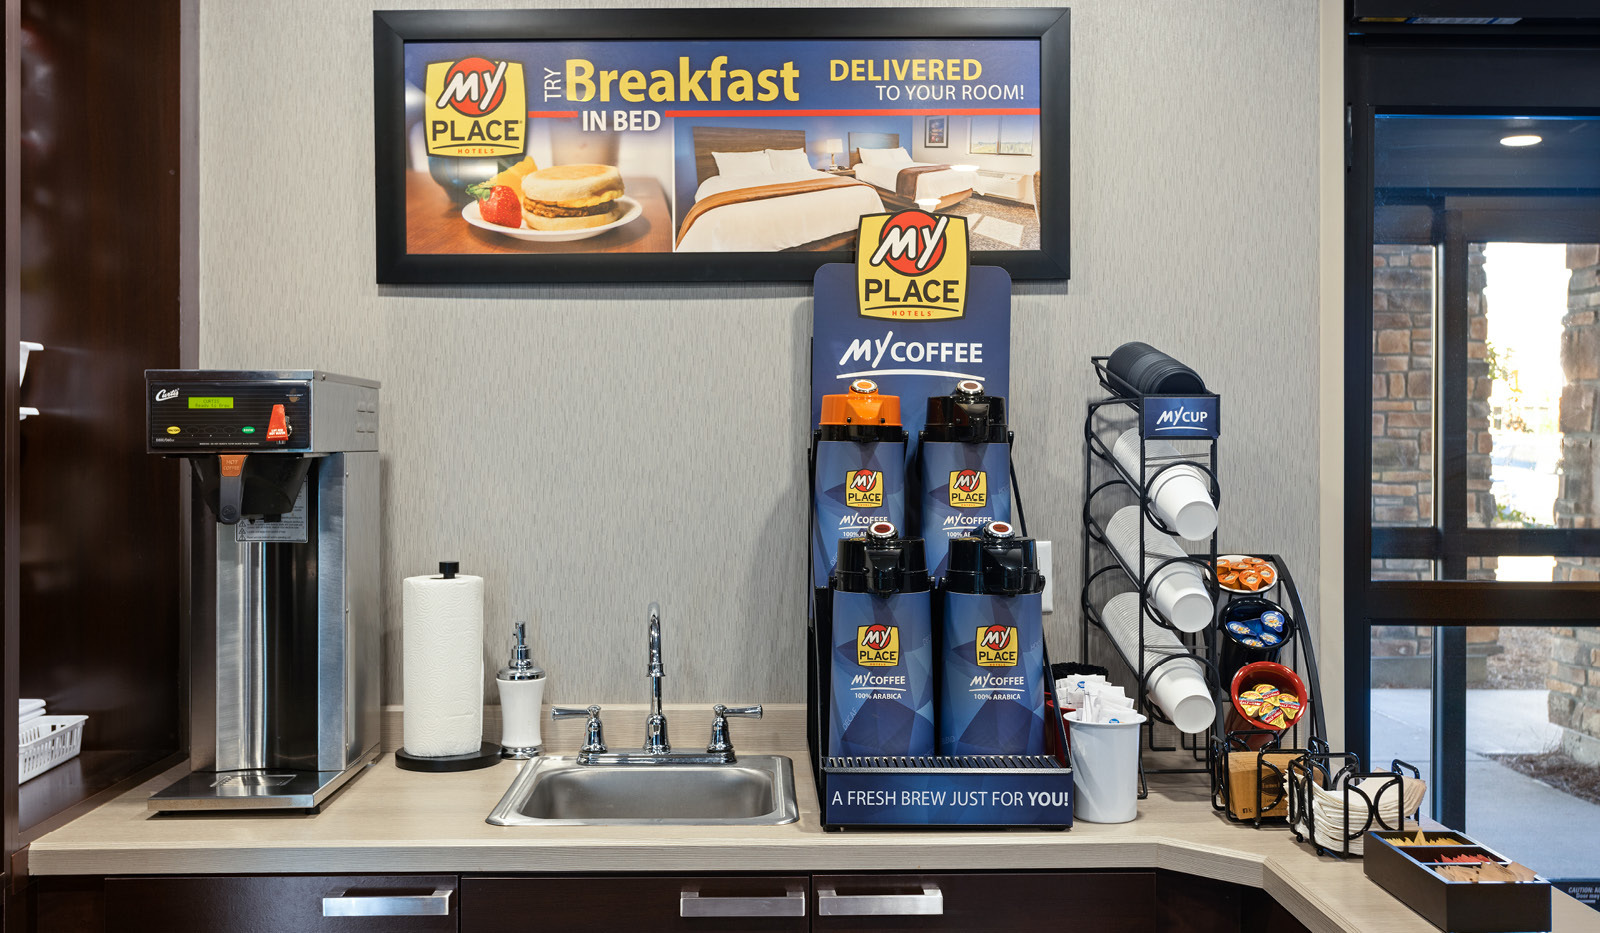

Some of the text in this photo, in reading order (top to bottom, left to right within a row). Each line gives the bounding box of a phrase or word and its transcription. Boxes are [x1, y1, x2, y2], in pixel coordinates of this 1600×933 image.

[829, 59, 982, 81] DELIVERED
[543, 67, 562, 102] TRY
[566, 56, 800, 102] Breakfast
[875, 84, 1025, 101] TO YOUR ROOM!
[582, 110, 661, 132] IN BED
[432, 119, 520, 142] PLACE
[864, 279, 960, 303] PLACE
[155, 388, 179, 401] Curtis
[848, 493, 881, 502] PLACE
[951, 493, 985, 502] PLACE
[860, 651, 896, 661] PLACE
[979, 651, 1016, 661] PLACE
[832, 790, 1069, 807] A FRESH BREW JUST FOR YOU!
